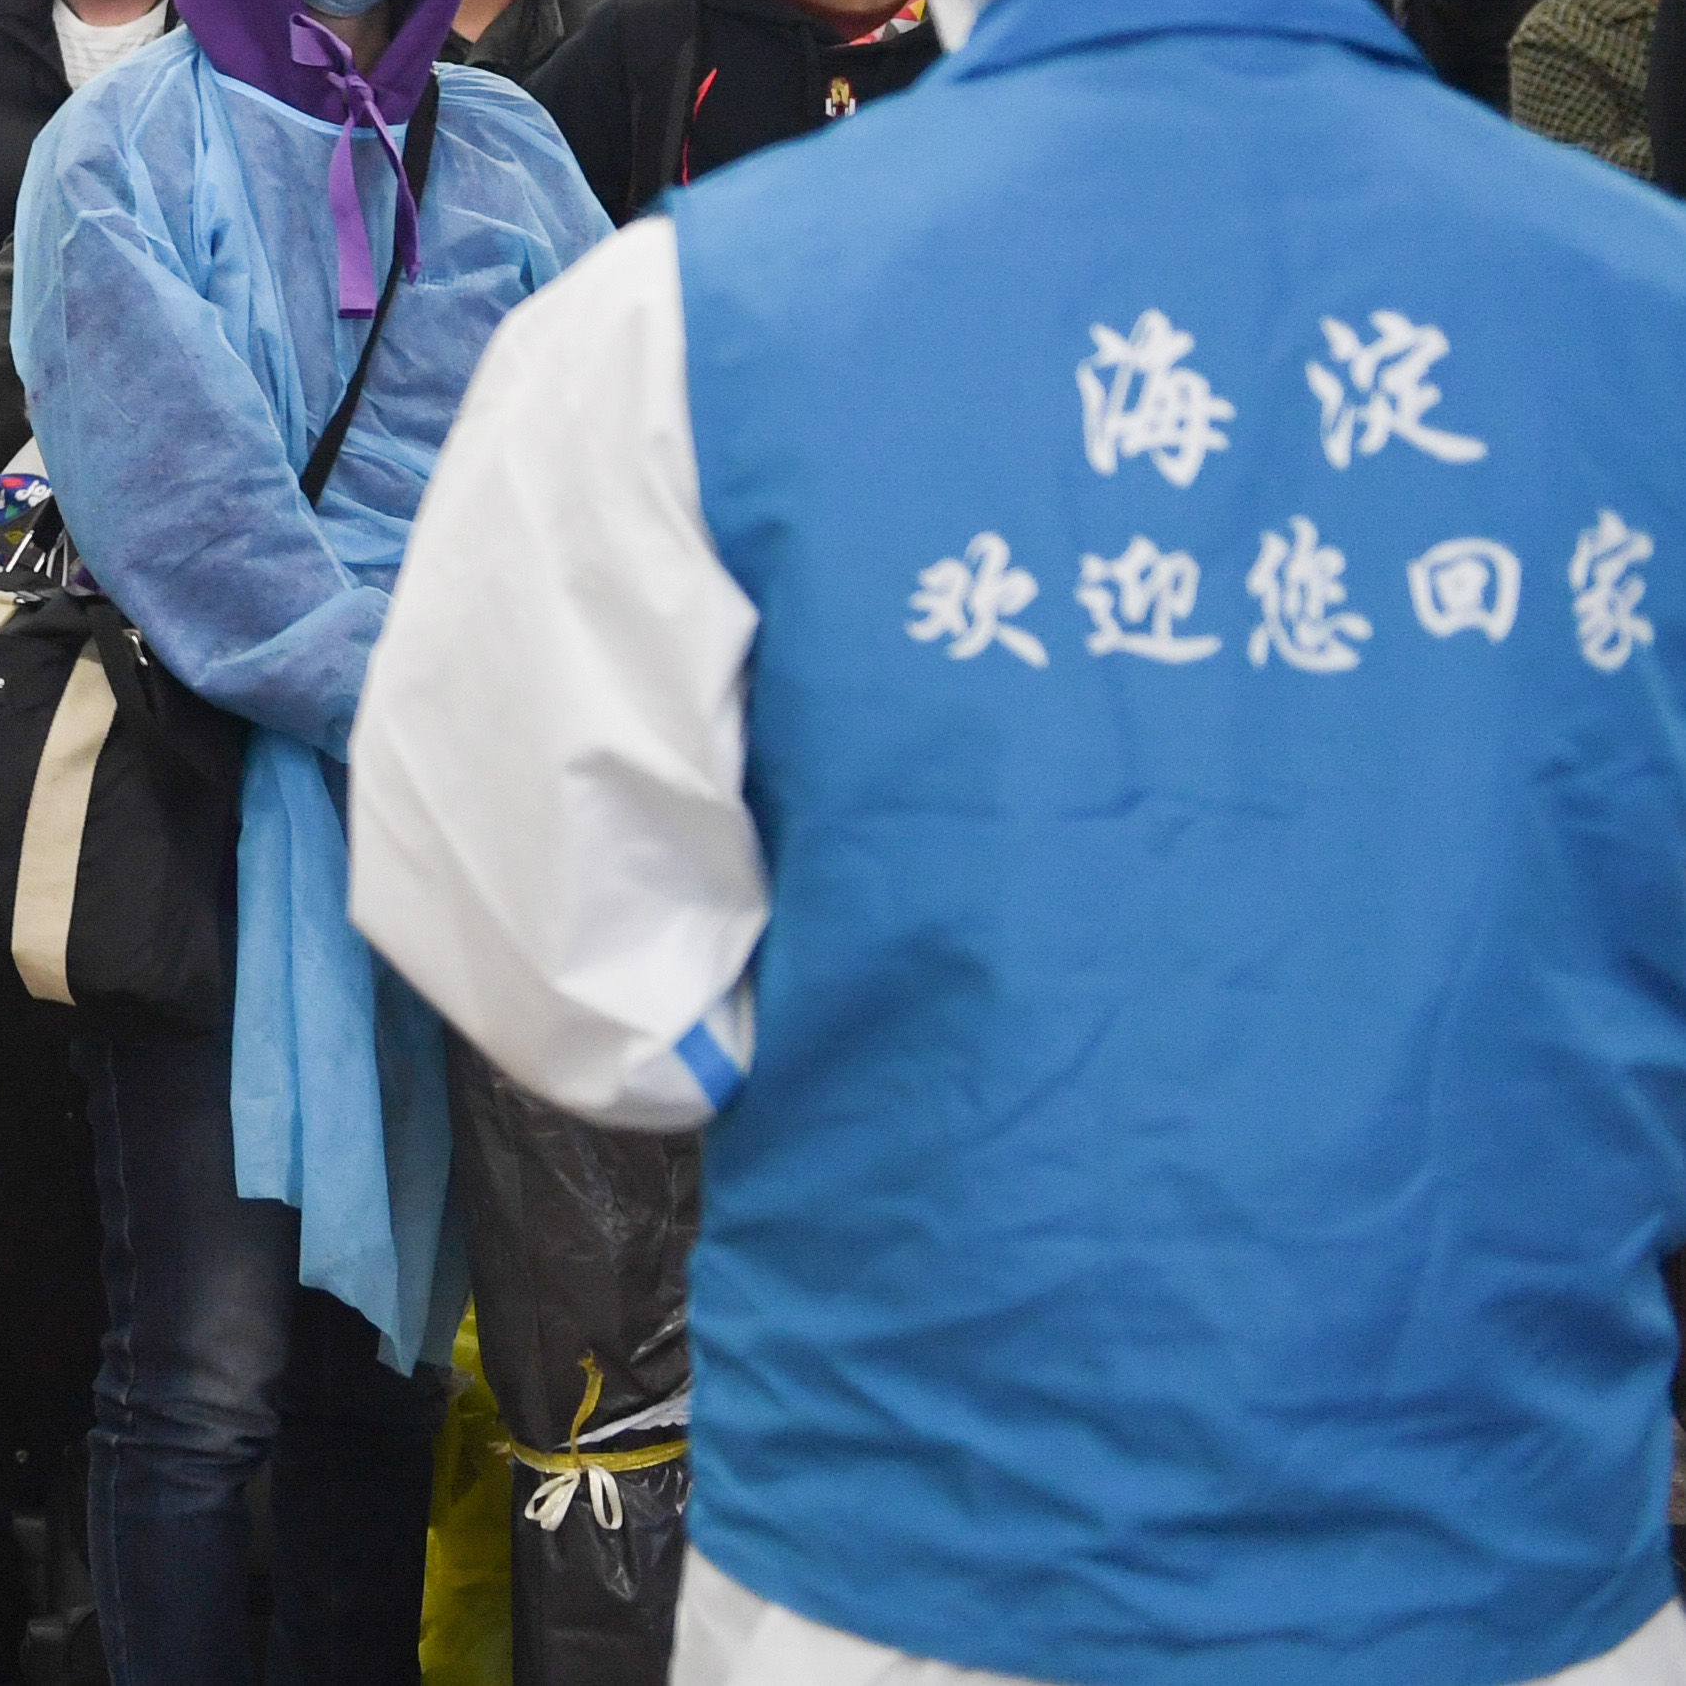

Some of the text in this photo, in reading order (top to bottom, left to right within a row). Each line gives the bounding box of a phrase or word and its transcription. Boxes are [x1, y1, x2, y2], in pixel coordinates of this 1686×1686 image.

[1074, 308, 1490, 489] 海淀
[905, 509, 1655, 674] 欢迎您回家
